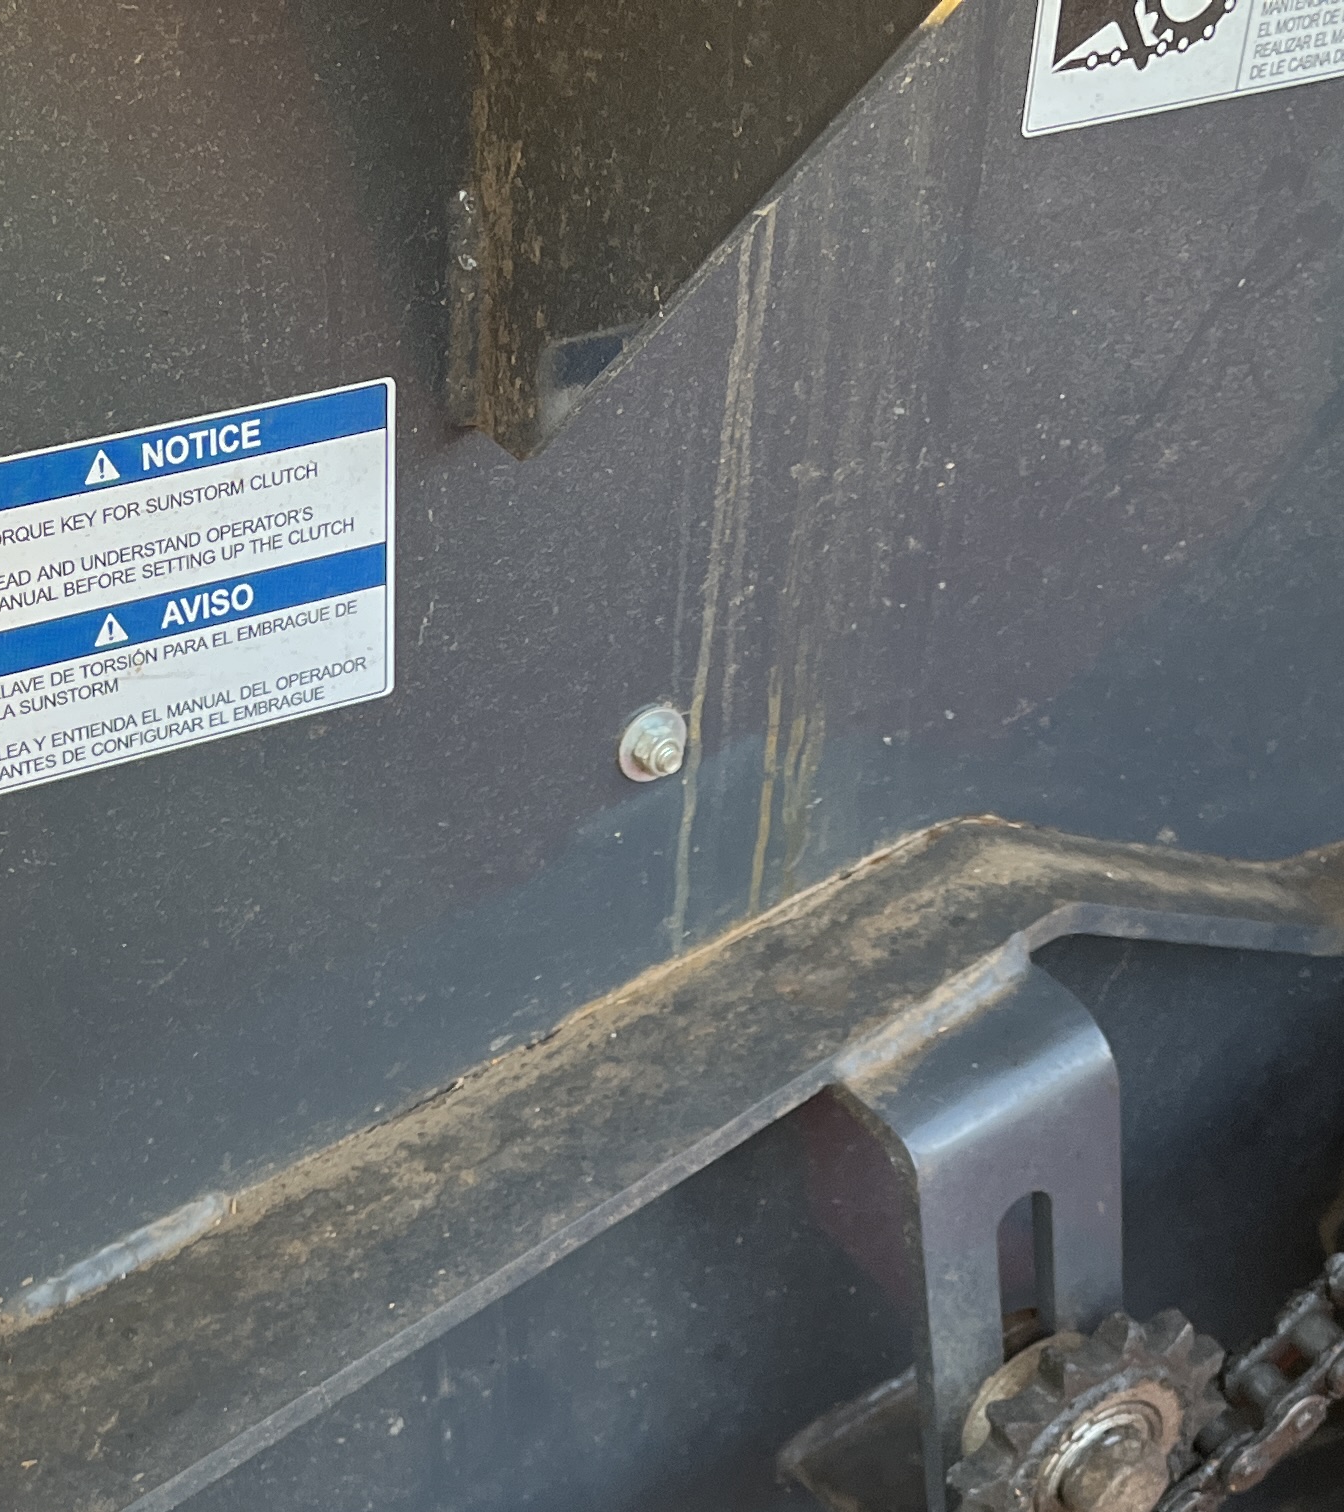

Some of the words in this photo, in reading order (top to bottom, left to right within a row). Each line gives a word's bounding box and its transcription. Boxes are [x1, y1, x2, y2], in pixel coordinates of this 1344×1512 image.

[1253, 34, 1312, 59] REALIZAR
[1314, 31, 1328, 48] EL
[1257, 22, 1271, 38] EL
[1274, 12, 1320, 35] MOTOR
[1322, 8, 1341, 26] DE
[1249, 62, 1268, 80] DE
[1270, 59, 1286, 76] LE
[141, 418, 262, 471] NOTICE
[60, 509, 97, 534] KEY
[102, 501, 140, 525] FOR
[145, 478, 244, 514] SUNSTORM
[250, 462, 318, 491] CLUTCH
[37, 559, 75, 582] AND
[81, 531, 201, 572] UNDERSTAND
[206, 506, 314, 544] OPERATOR'S
[64, 566, 136, 597] BEFORE
[142, 549, 216, 579] SETTING
[221, 542, 245, 561] UP
[249, 533, 283, 555] THE
[288, 517, 355, 546] CLUTCH
[160, 583, 254, 630] AVISO
[50, 668, 75, 687] DE
[79, 647, 158, 680] TORSIÓN
[163, 636, 208, 660] PARA
[212, 631, 233, 648] EL
[237, 605, 330, 642] EMBRAGUE
[335, 600, 358, 618] DE
[19, 678, 119, 715] SUNSTORM
[33, 735, 47, 751] Y
[51, 714, 137, 748] ENTIENDA
[141, 707, 162, 725] EL
[167, 690, 235, 719] MANUAL
[240, 681, 272, 701] DEL
[276, 656, 367, 692] OPERADOR
[62, 746, 86, 765] DE
[91, 716, 203, 757] CONFIGURAR
[208, 711, 229, 728] EL
[233, 686, 325, 722] EMBRAGUE
